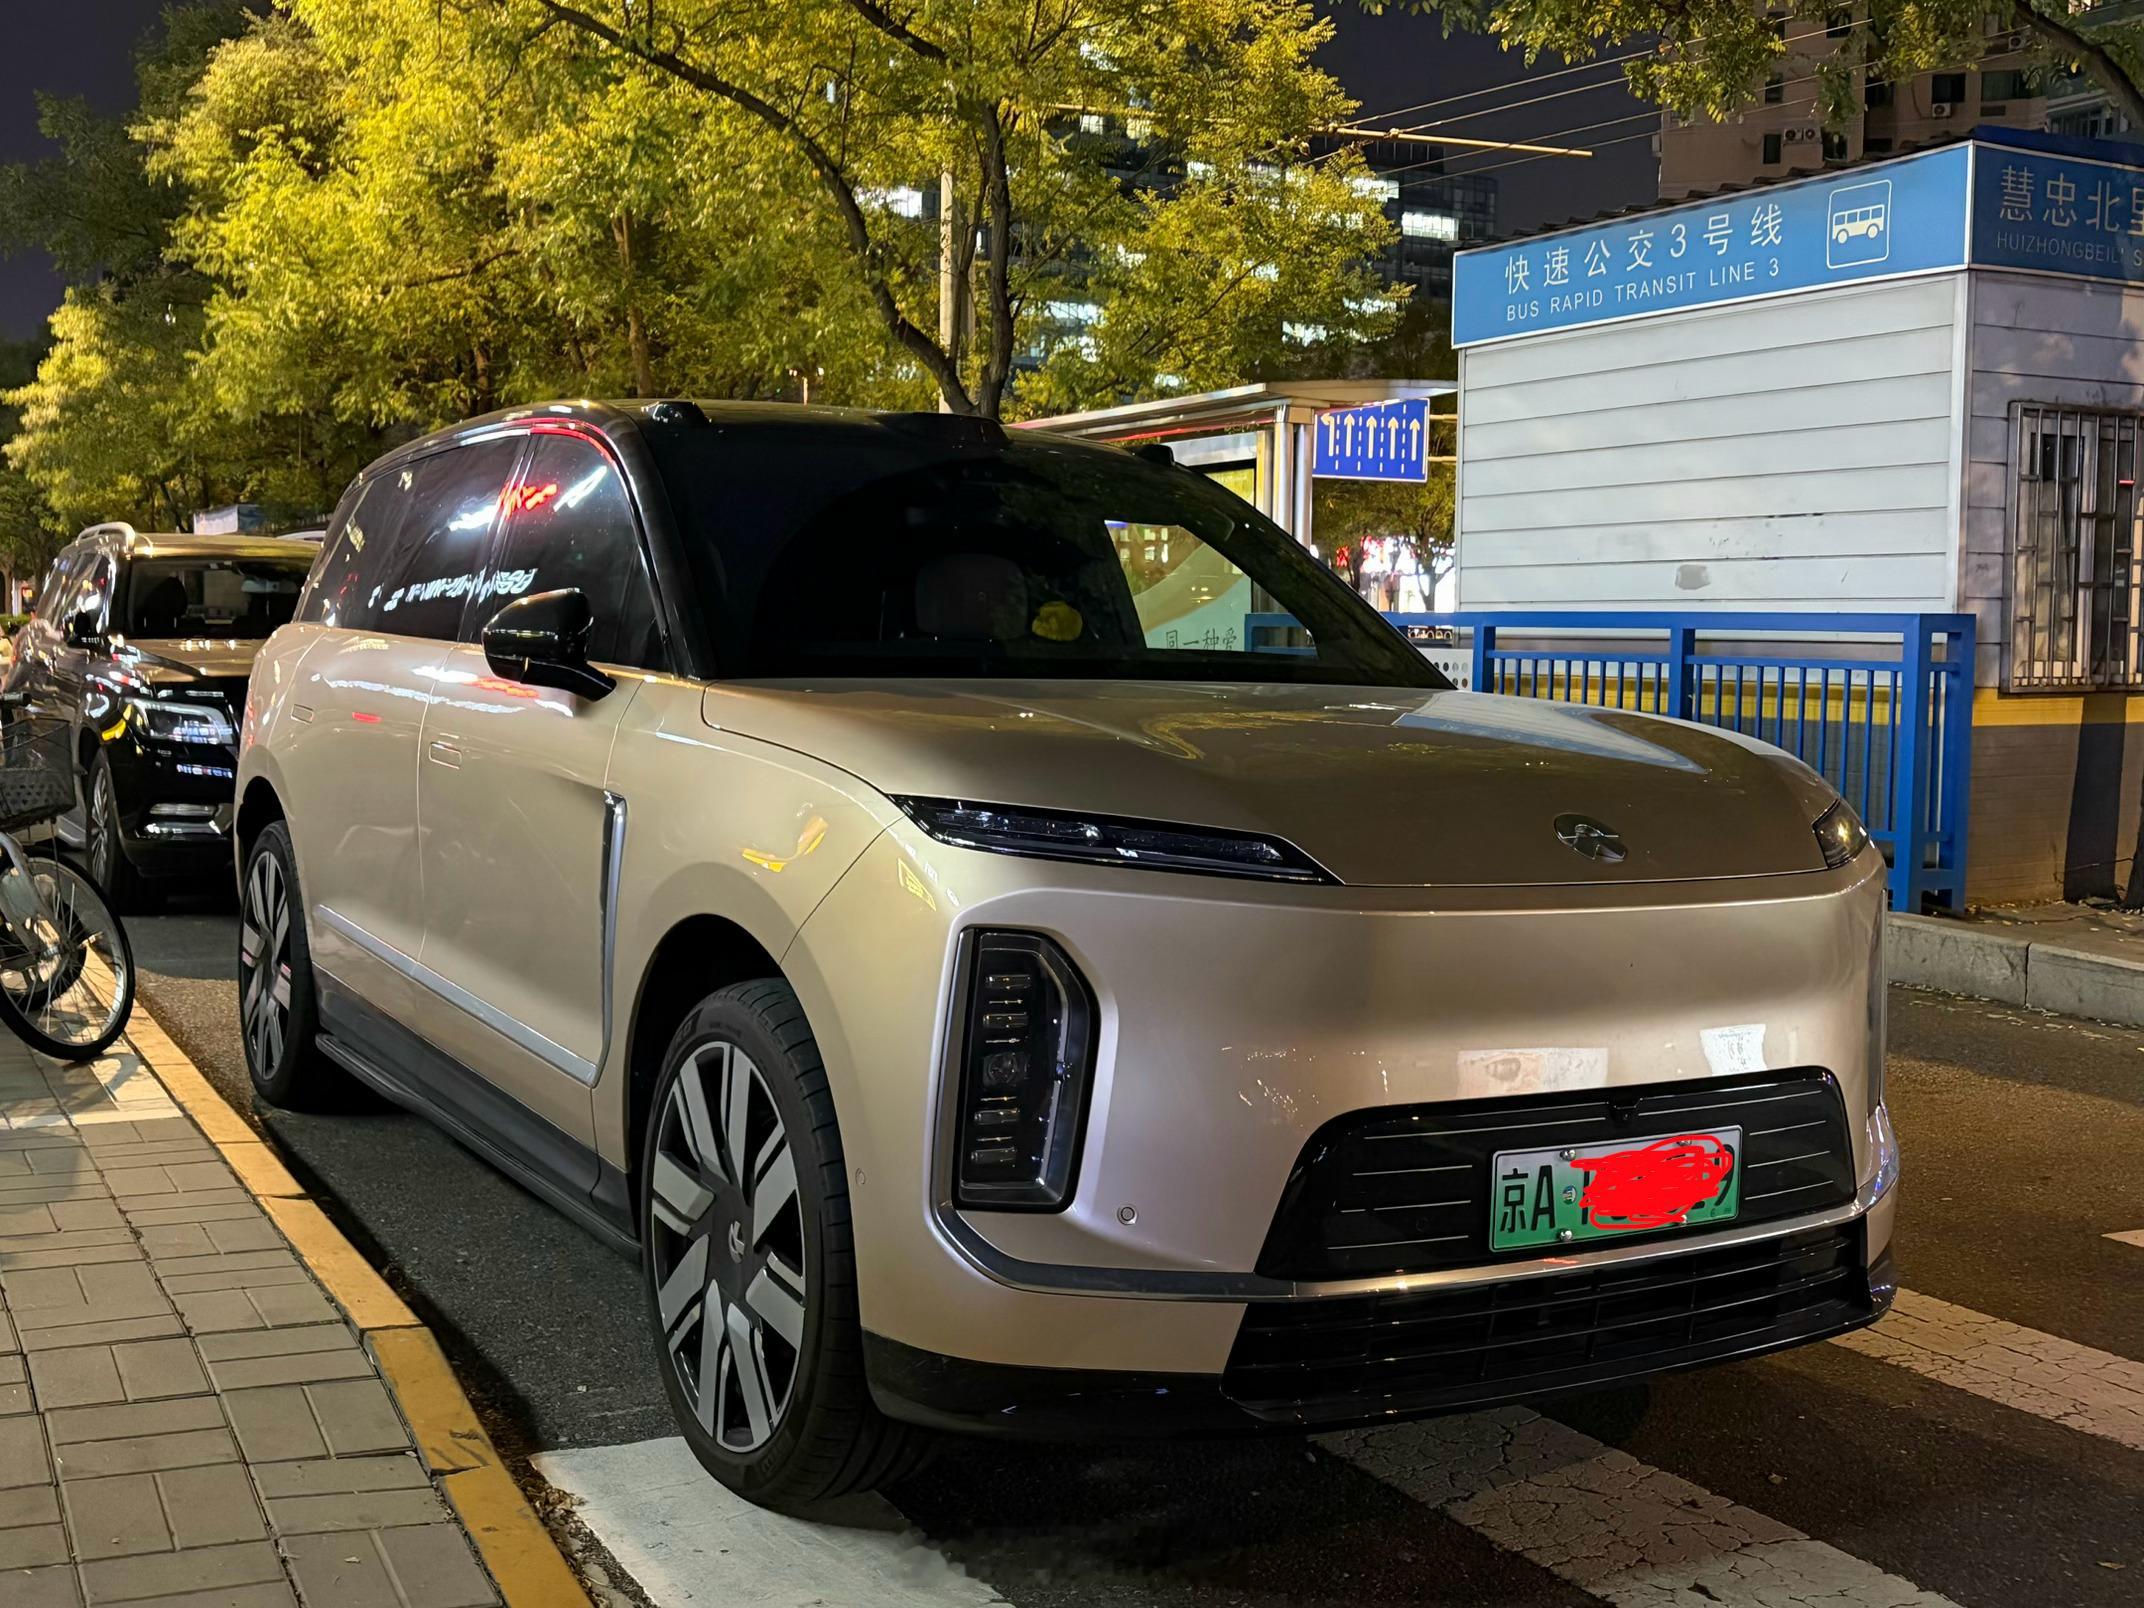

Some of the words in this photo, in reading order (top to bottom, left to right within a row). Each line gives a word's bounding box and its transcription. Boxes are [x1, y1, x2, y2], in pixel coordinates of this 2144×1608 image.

[1505, 204, 1783, 295] 快速公交3号线
[1506, 301, 1540, 322] BUS
[1550, 289, 1603, 314] RAPID
[1615, 271, 1697, 303] TRANSIT
[1709, 261, 1755, 287] LINE
[1769, 257, 1780, 277] 3
